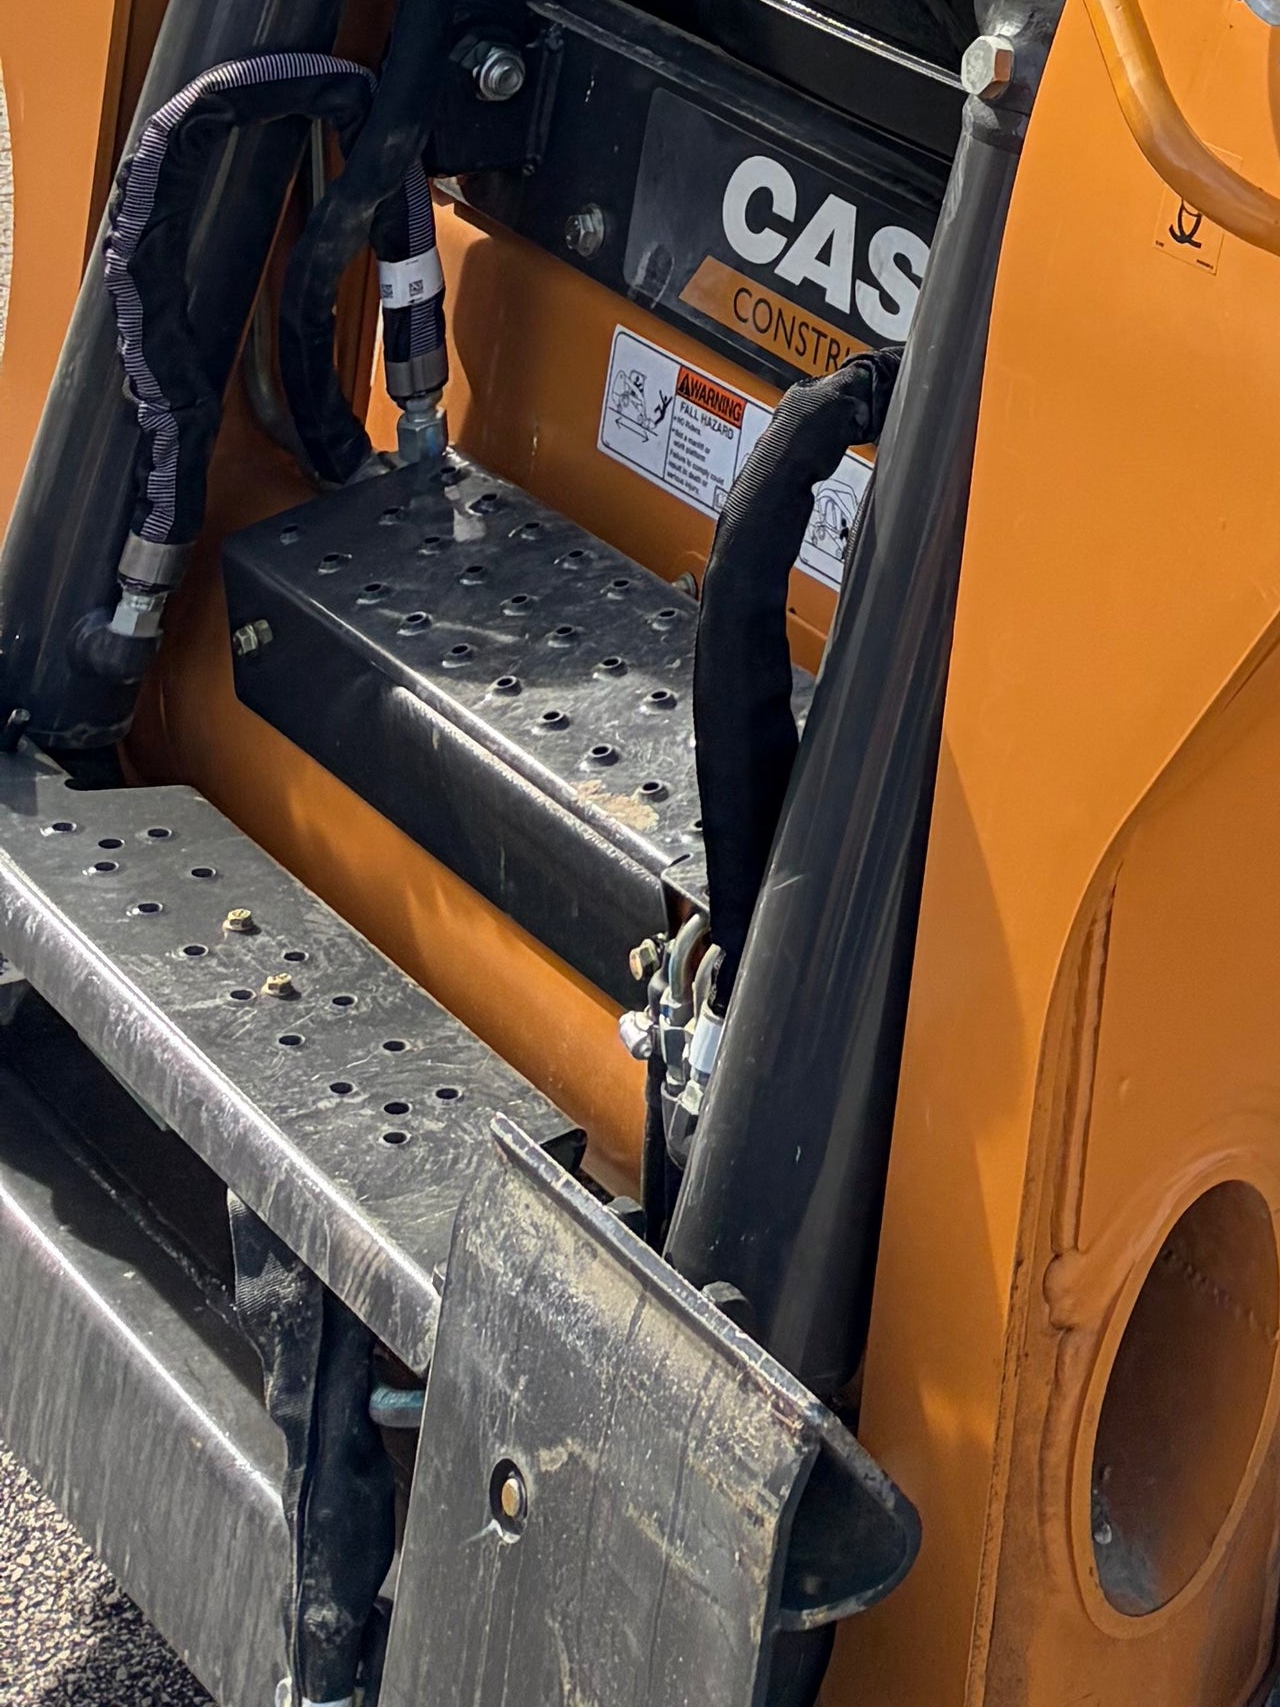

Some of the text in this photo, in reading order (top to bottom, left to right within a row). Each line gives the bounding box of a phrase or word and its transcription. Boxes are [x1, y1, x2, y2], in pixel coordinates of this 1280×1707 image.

[722, 155, 930, 342] CAS
[733, 287, 850, 373] CONSTR
[680, 401, 734, 440] FALL HAZARD
[690, 378, 742, 421] WARNING
